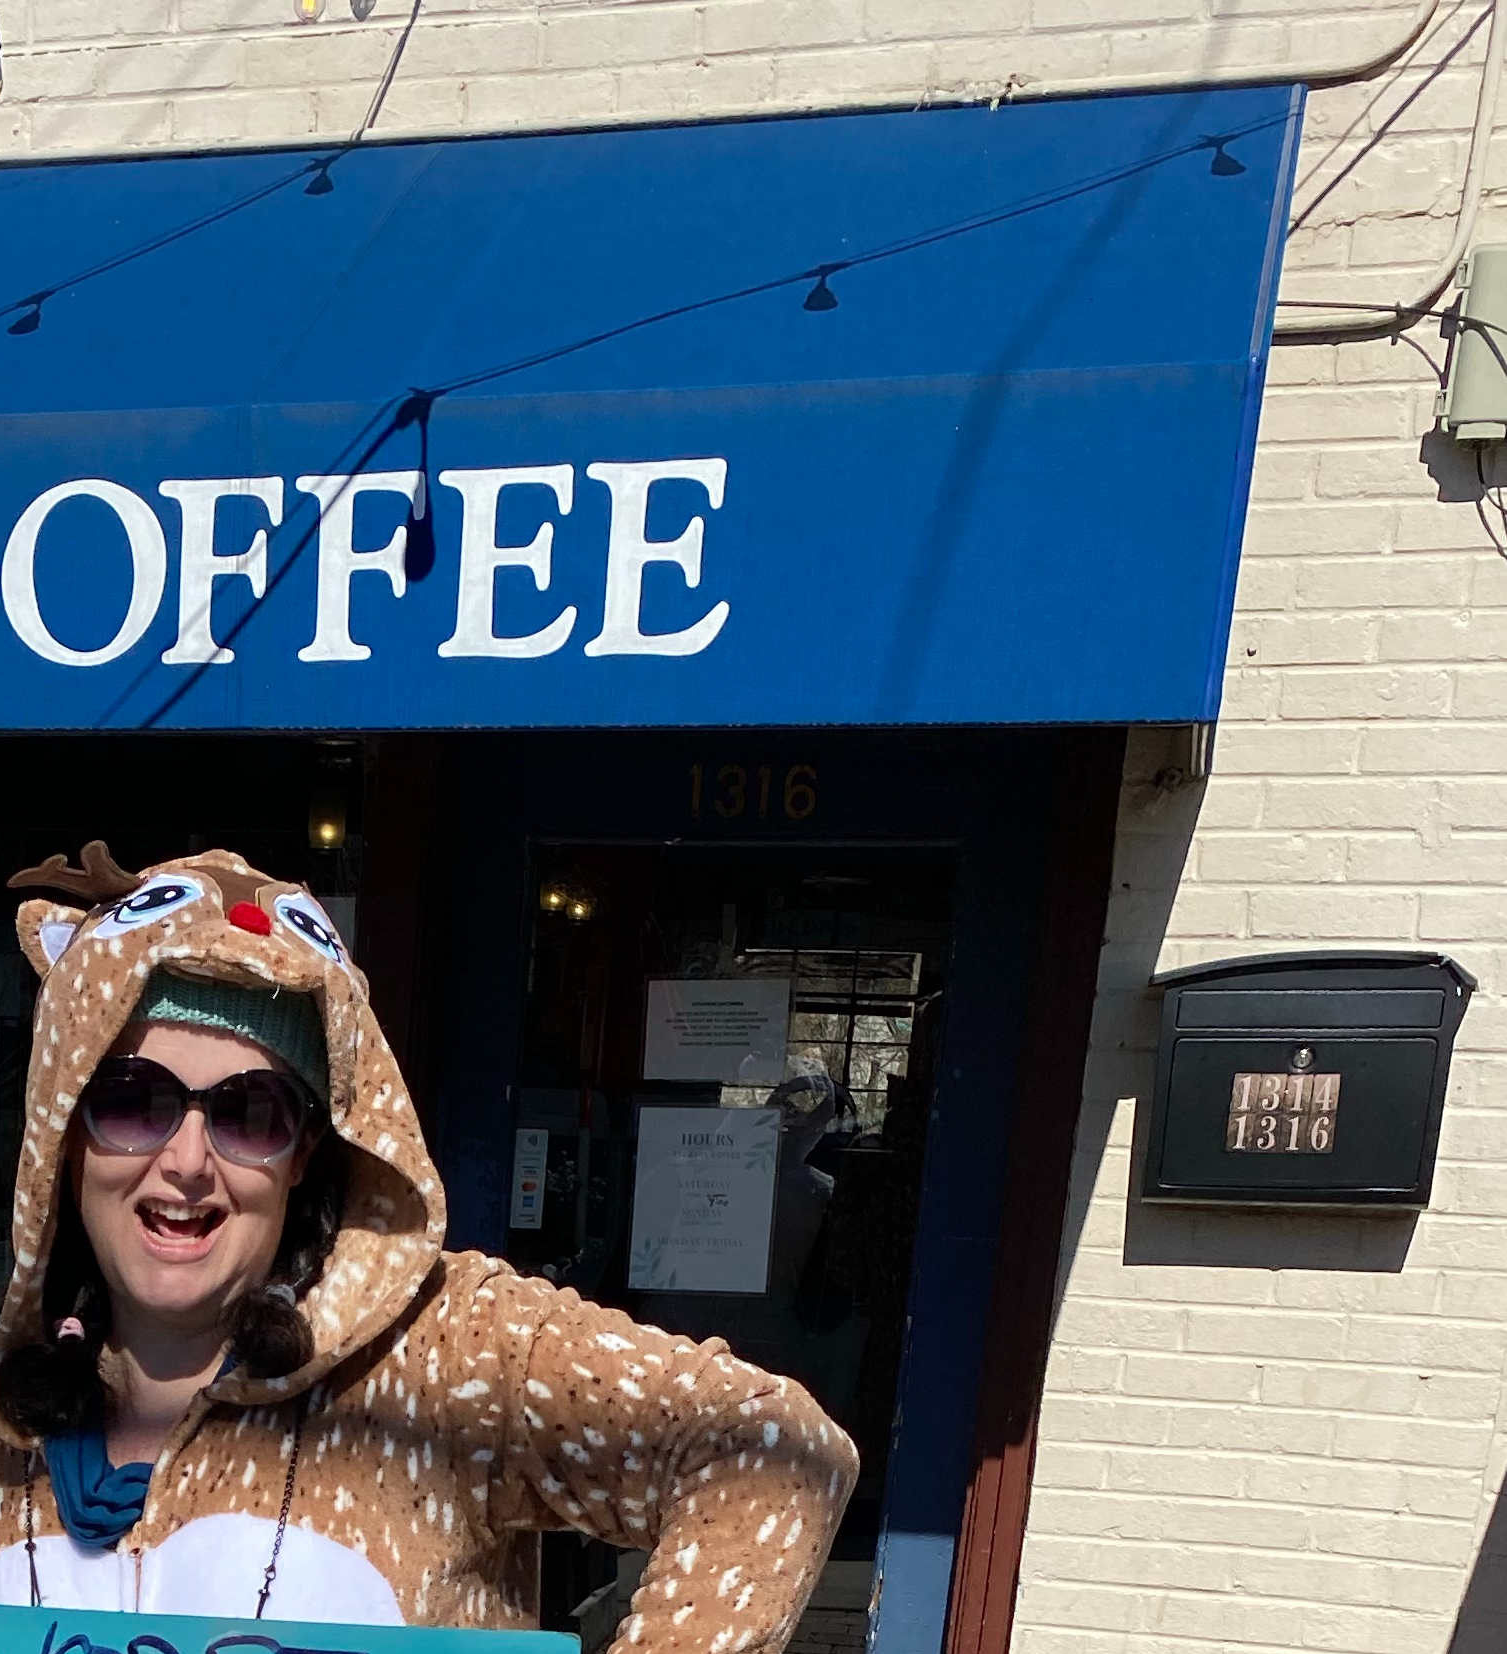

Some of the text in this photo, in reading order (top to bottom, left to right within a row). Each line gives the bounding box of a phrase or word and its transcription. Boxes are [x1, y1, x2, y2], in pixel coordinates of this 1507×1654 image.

[690, 763, 817, 819] 1316
[1237, 1075, 1334, 1111] 1314
[681, 1132, 734, 1146] HOURS
[1232, 1115, 1329, 1151] 1316
